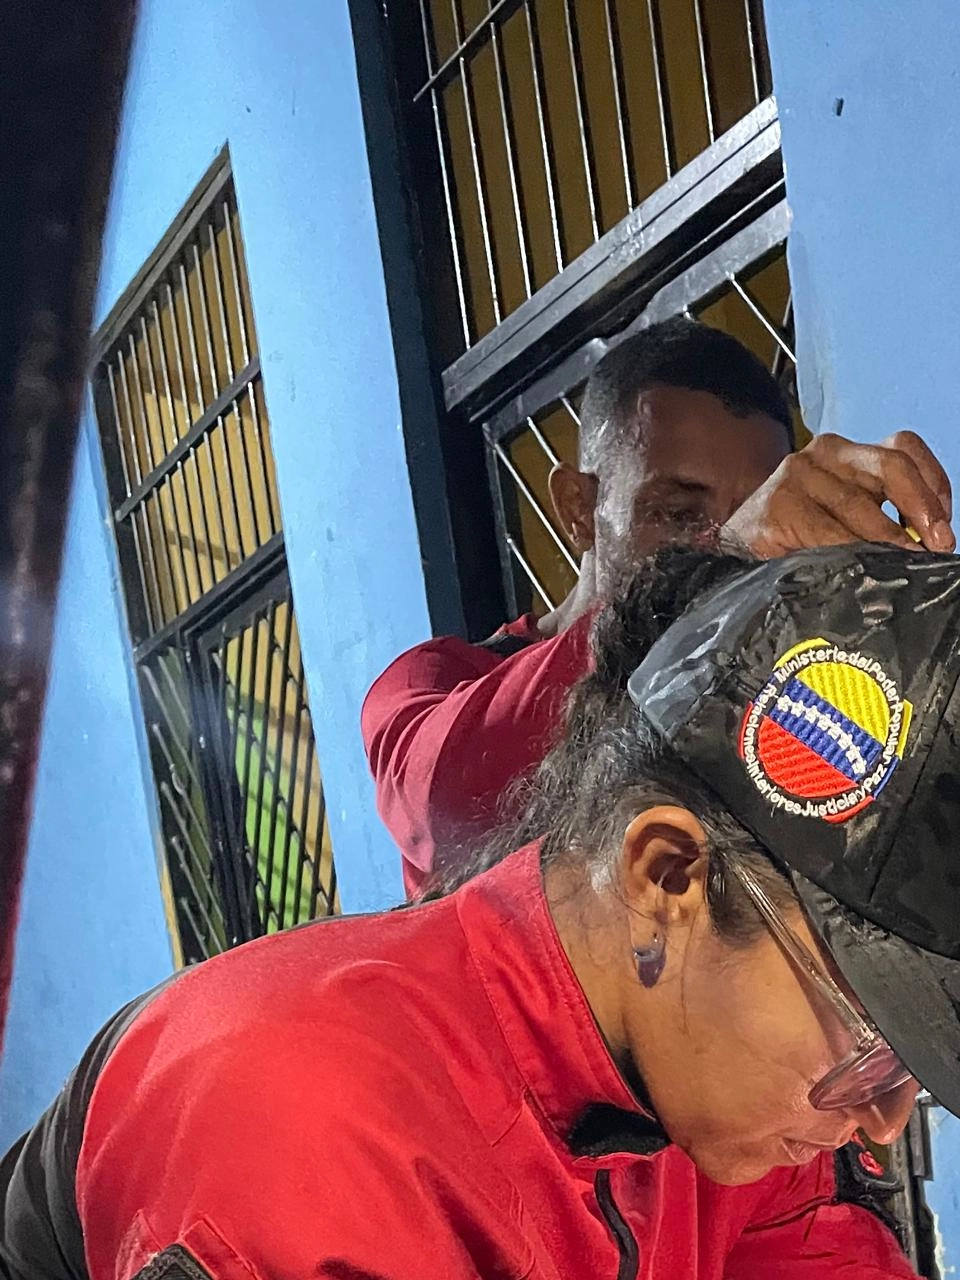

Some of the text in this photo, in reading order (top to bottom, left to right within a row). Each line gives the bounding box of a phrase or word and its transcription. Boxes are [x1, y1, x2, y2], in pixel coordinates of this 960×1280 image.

[869, 661, 900, 702] Poder
[882, 701, 904, 765] Popular
[863, 764, 888, 793] Paz
